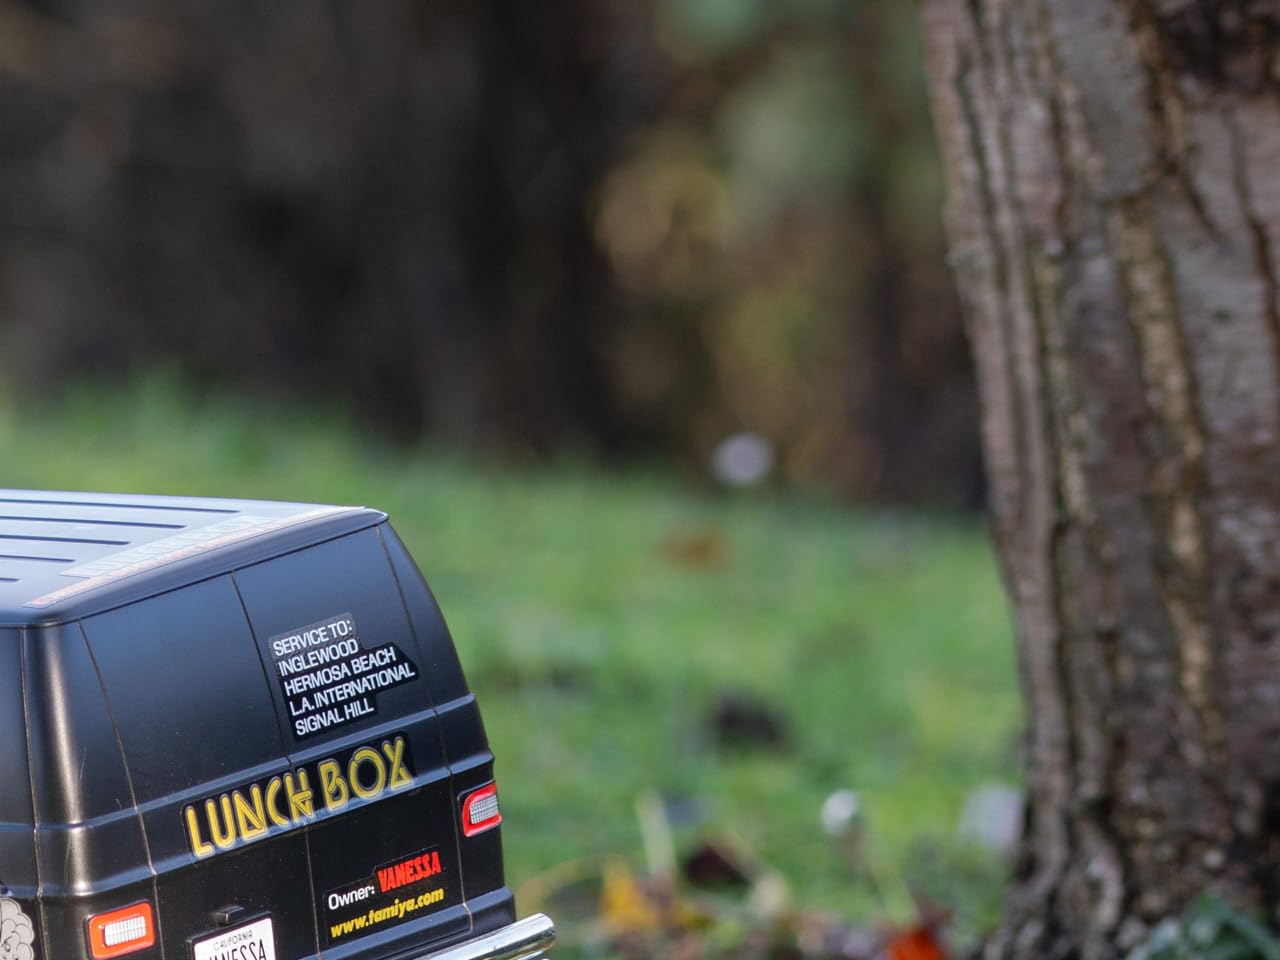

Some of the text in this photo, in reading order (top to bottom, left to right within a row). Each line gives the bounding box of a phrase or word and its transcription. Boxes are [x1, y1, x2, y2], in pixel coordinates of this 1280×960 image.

[273, 620, 353, 656] SERVICE TO:
[278, 639, 359, 677] INGLEWOOD
[284, 646, 397, 696] HERMOSA BEACH
[289, 662, 416, 716] L.A. INTERNATIONAL
[295, 698, 375, 736] SIGNAL HILL
[186, 736, 413, 857] LUNCH BOX
[328, 851, 442, 910] Owner: VANESSA
[330, 888, 445, 938] www.tamiya.com
